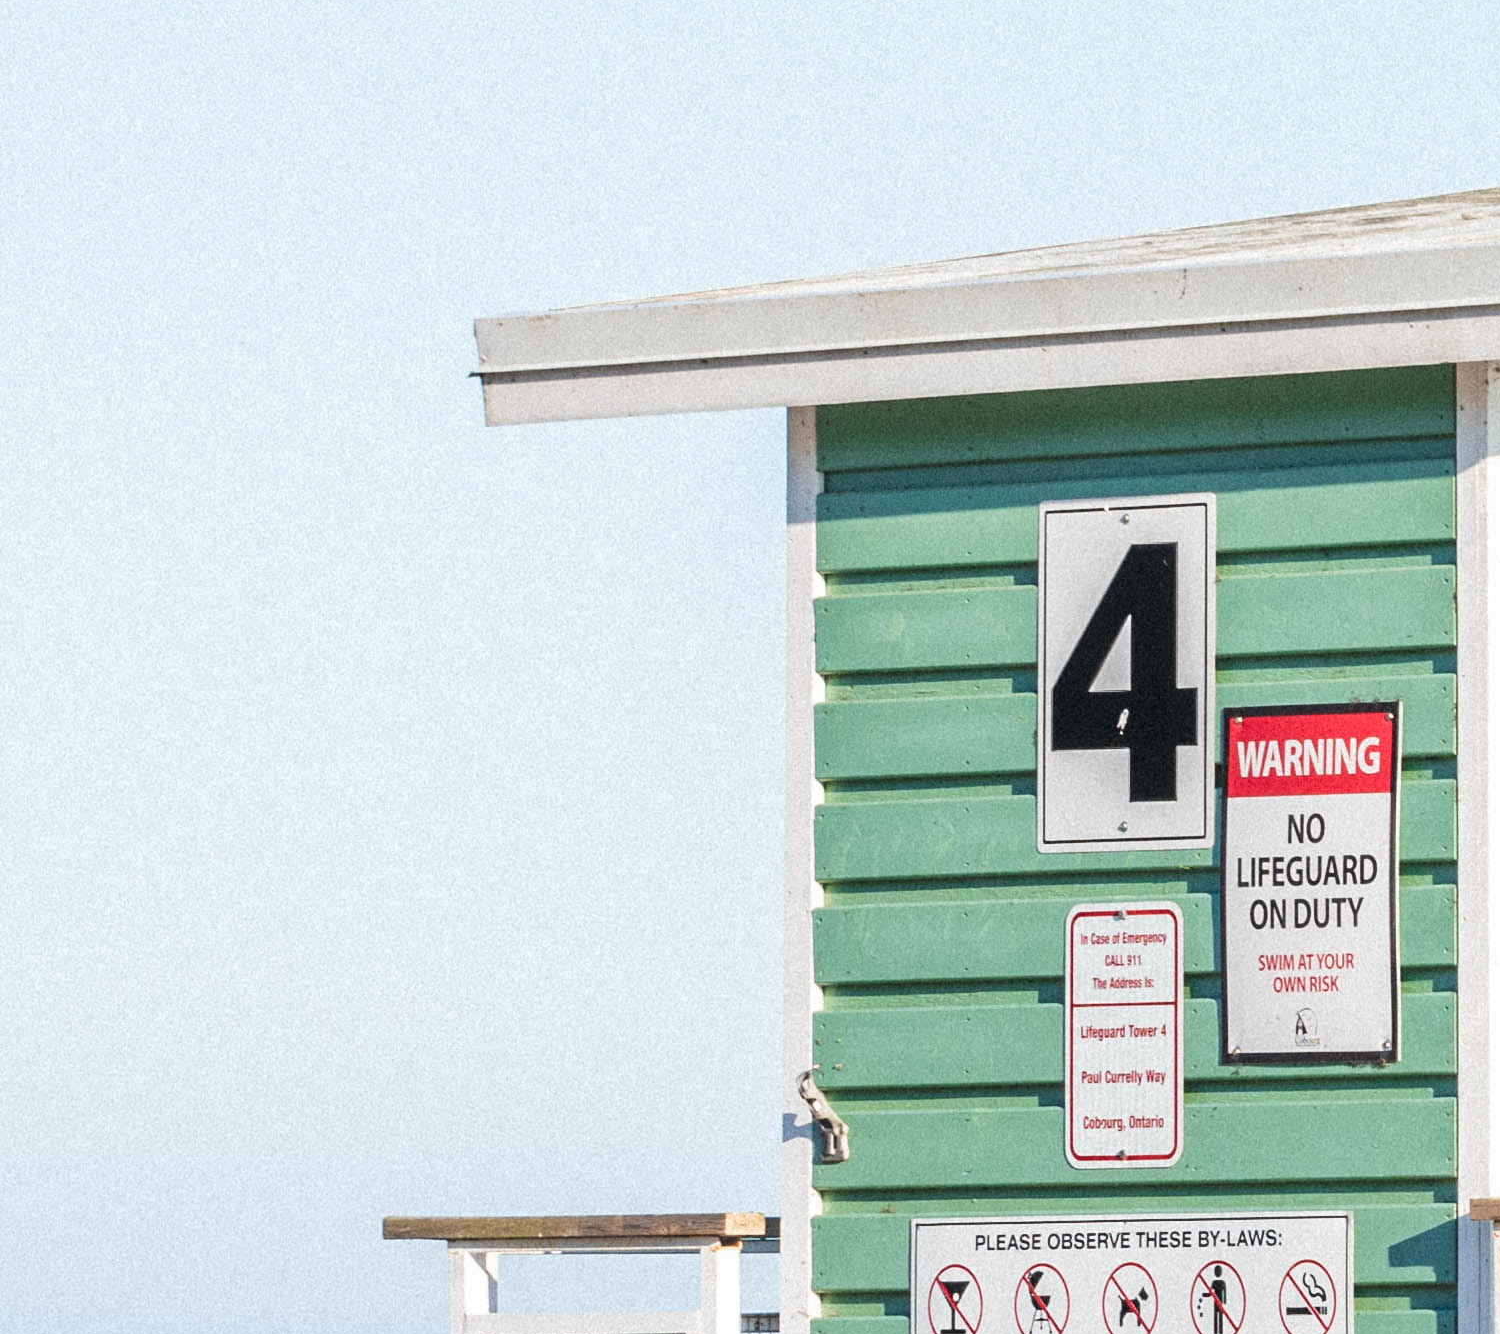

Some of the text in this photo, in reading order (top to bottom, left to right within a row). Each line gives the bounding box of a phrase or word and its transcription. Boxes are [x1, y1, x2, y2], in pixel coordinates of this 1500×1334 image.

[1052, 541, 1198, 803] 4
[1237, 736, 1381, 778] WARNING
[1287, 813, 1326, 844] NO
[1237, 854, 1378, 888] LIFEGUARD
[1250, 897, 1364, 930] ON DUTY
[1081, 932, 1167, 946] In Case of Emergency
[1105, 954, 1142, 967] CALL 911
[1258, 953, 1355, 972] SWIM AT YOUR
[1093, 977, 1107, 989] The
[1110, 977, 1142, 989] Address
[1273, 976, 1339, 993] OWN RISK
[1081, 1024, 1167, 1042] Lifeguard Tower 4
[1081, 1070, 1166, 1086] Paul Currelly Way
[1083, 1115, 1164, 1132] Cobourg, Ontario
[975, 1228, 1283, 1251] PLEASE OBSERVE THESE BY-LAWS:
